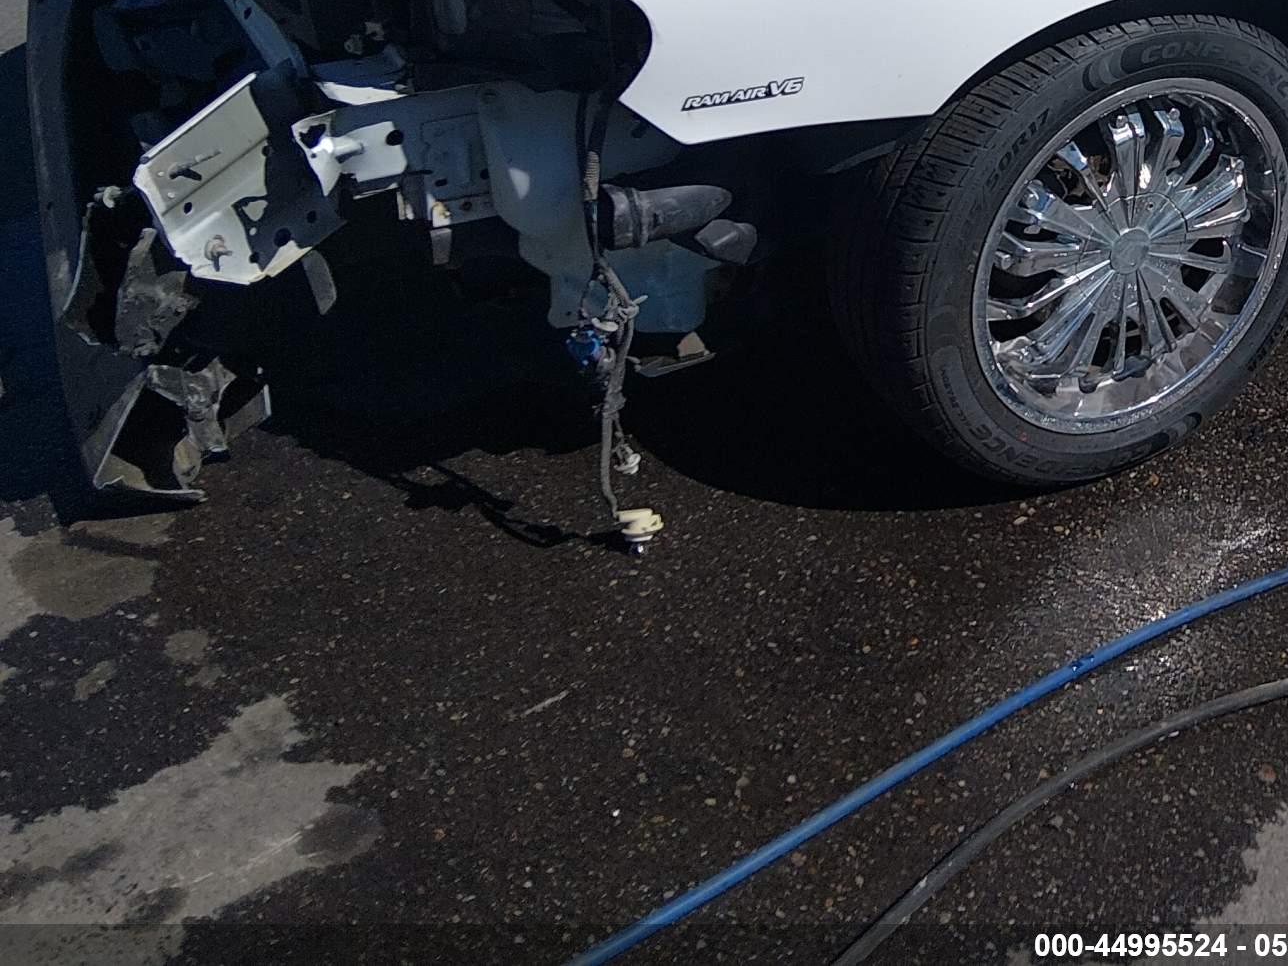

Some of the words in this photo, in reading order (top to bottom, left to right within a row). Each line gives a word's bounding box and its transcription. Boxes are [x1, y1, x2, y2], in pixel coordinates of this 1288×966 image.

[681, 91, 732, 111] RAM
[730, 85, 768, 103] AIR
[767, 77, 804, 97] V6
